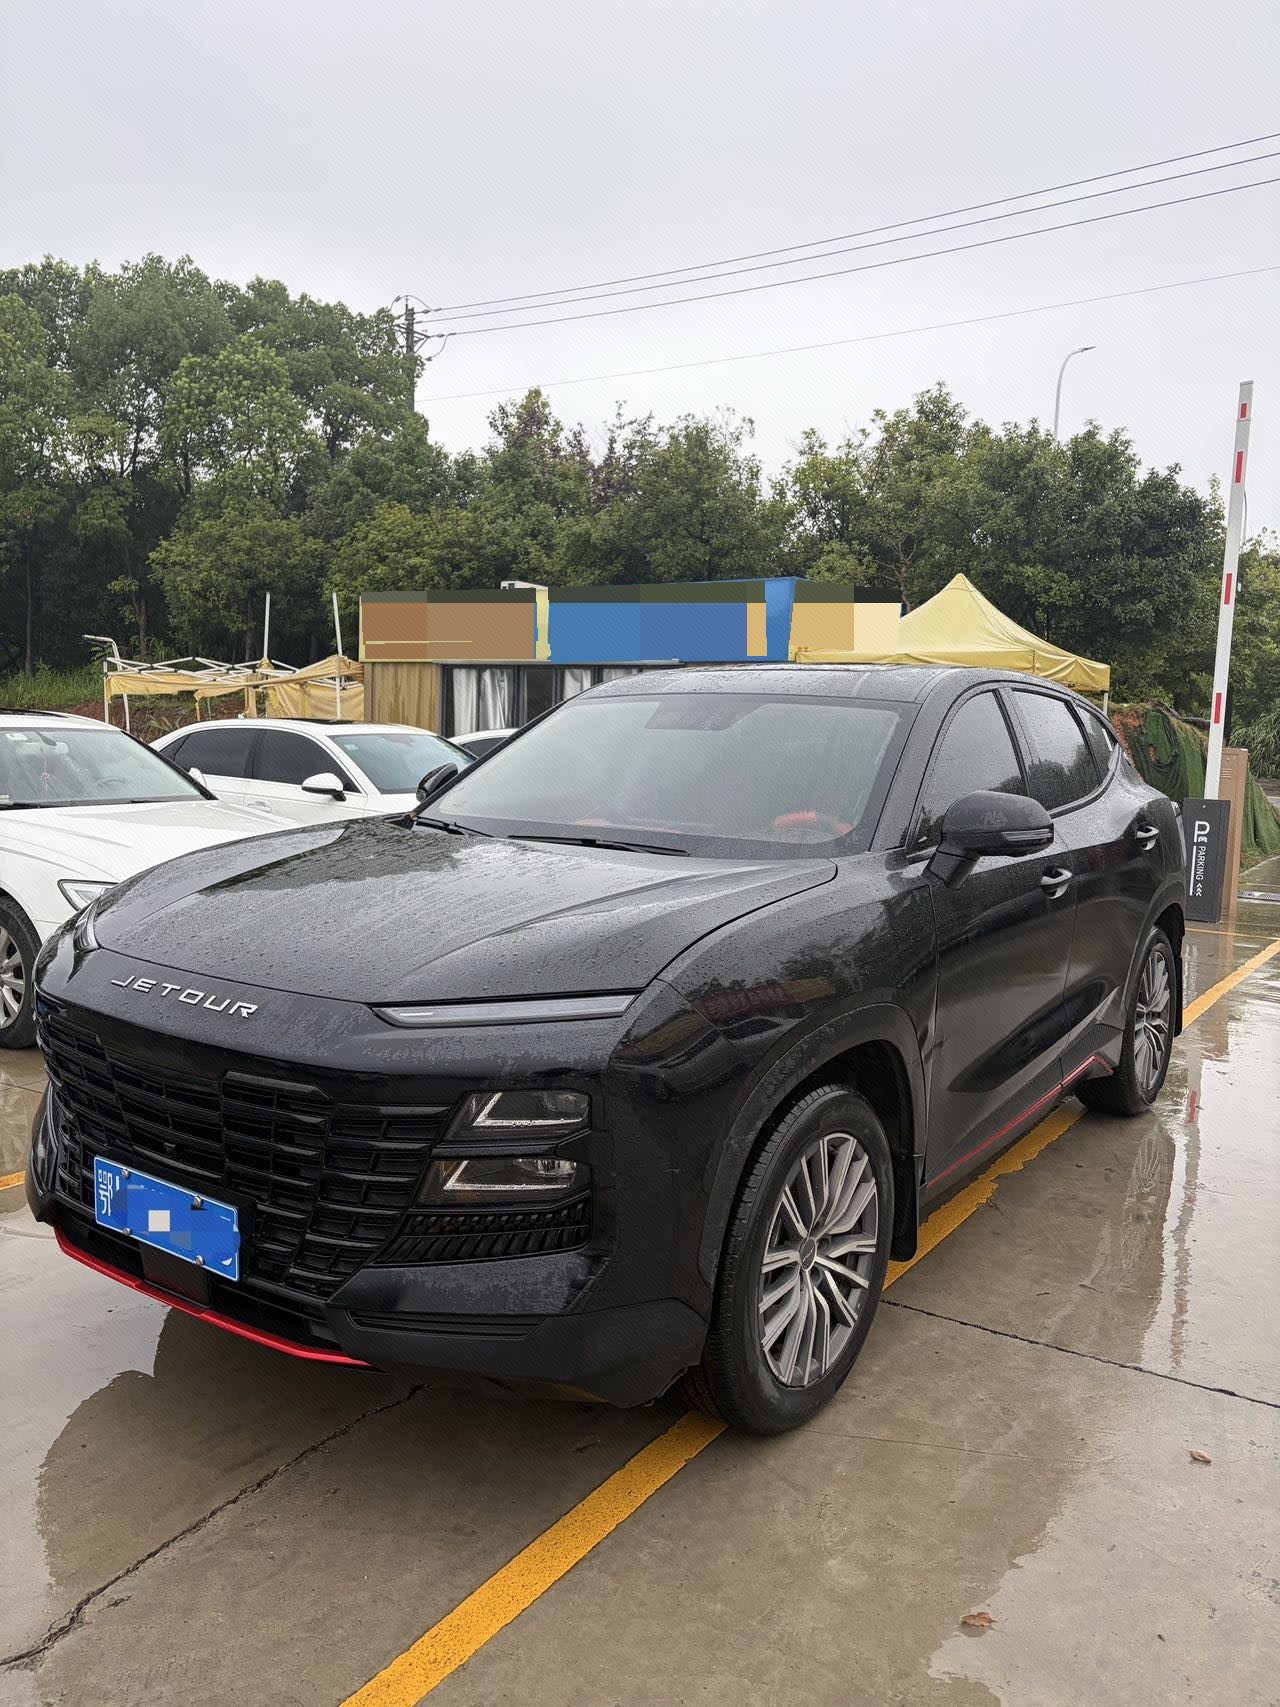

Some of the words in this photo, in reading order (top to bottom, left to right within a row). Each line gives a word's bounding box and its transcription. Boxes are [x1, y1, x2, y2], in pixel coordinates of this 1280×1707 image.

[1194, 821, 1210, 842] P
[1196, 846, 1206, 880] PARKING
[111, 975, 258, 1018] JETOUR
